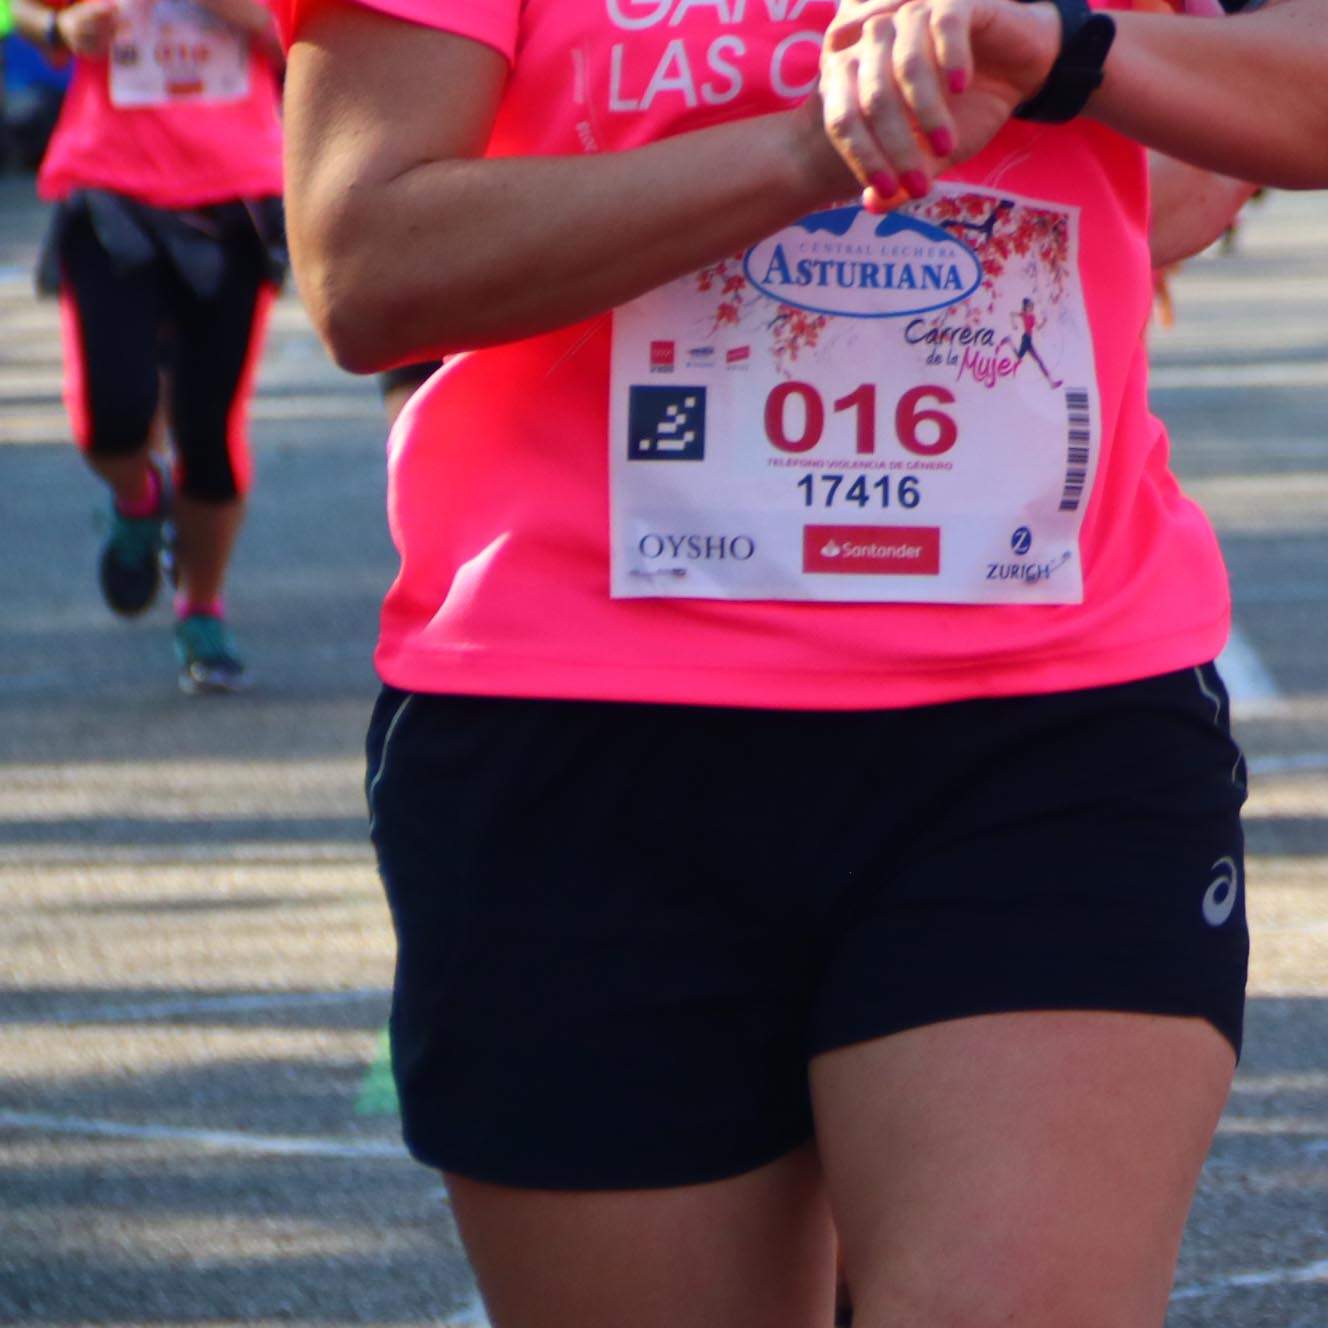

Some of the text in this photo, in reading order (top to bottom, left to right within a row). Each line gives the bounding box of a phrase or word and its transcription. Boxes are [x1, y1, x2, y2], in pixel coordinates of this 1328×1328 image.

[608, 34, 744, 113] LAS
[762, 243, 965, 290] ASTURIANA
[904, 318, 995, 347] Carrera
[926, 346, 1022, 389] de la Mujer
[764, 381, 958, 456] 016
[797, 473, 921, 509] 17416
[639, 534, 755, 561] OYSHO
[842, 540, 923, 560] Santander
[986, 562, 1051, 582] ZURICH
